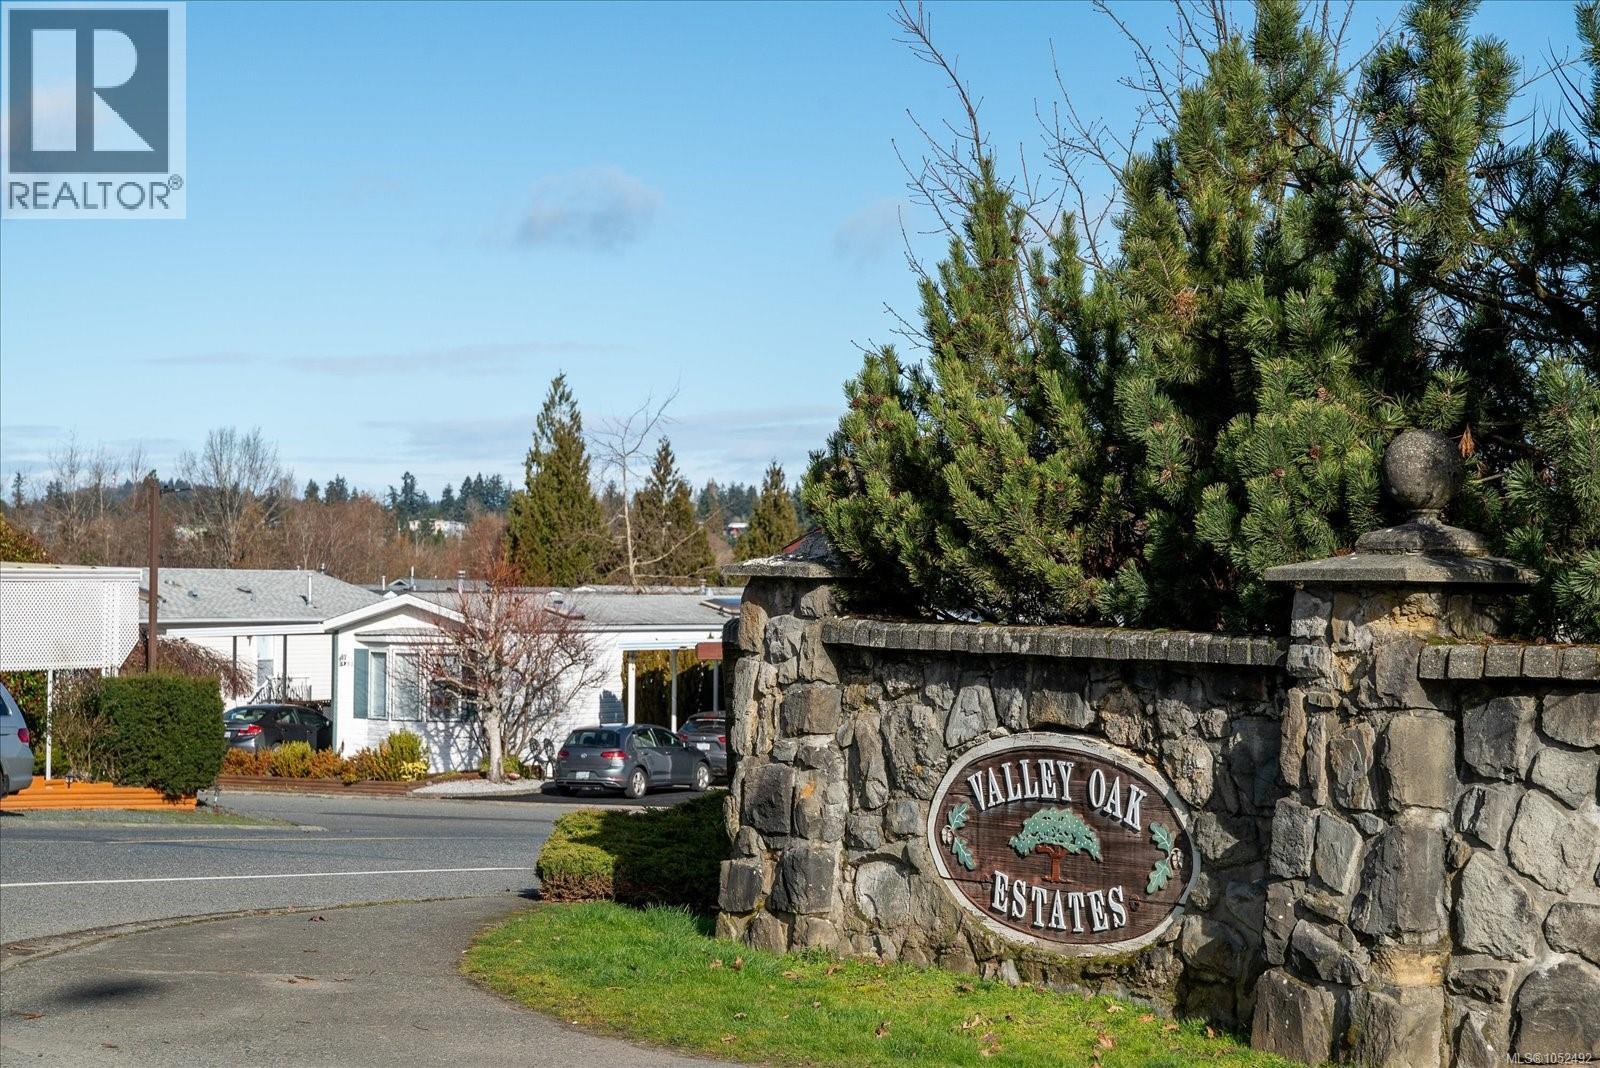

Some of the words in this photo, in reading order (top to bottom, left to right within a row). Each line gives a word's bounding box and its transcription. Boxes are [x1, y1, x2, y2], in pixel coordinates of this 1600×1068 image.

[967, 759, 1074, 811] VALLEY
[1088, 768, 1147, 832] OAK
[991, 869, 1127, 933] ESTATES
